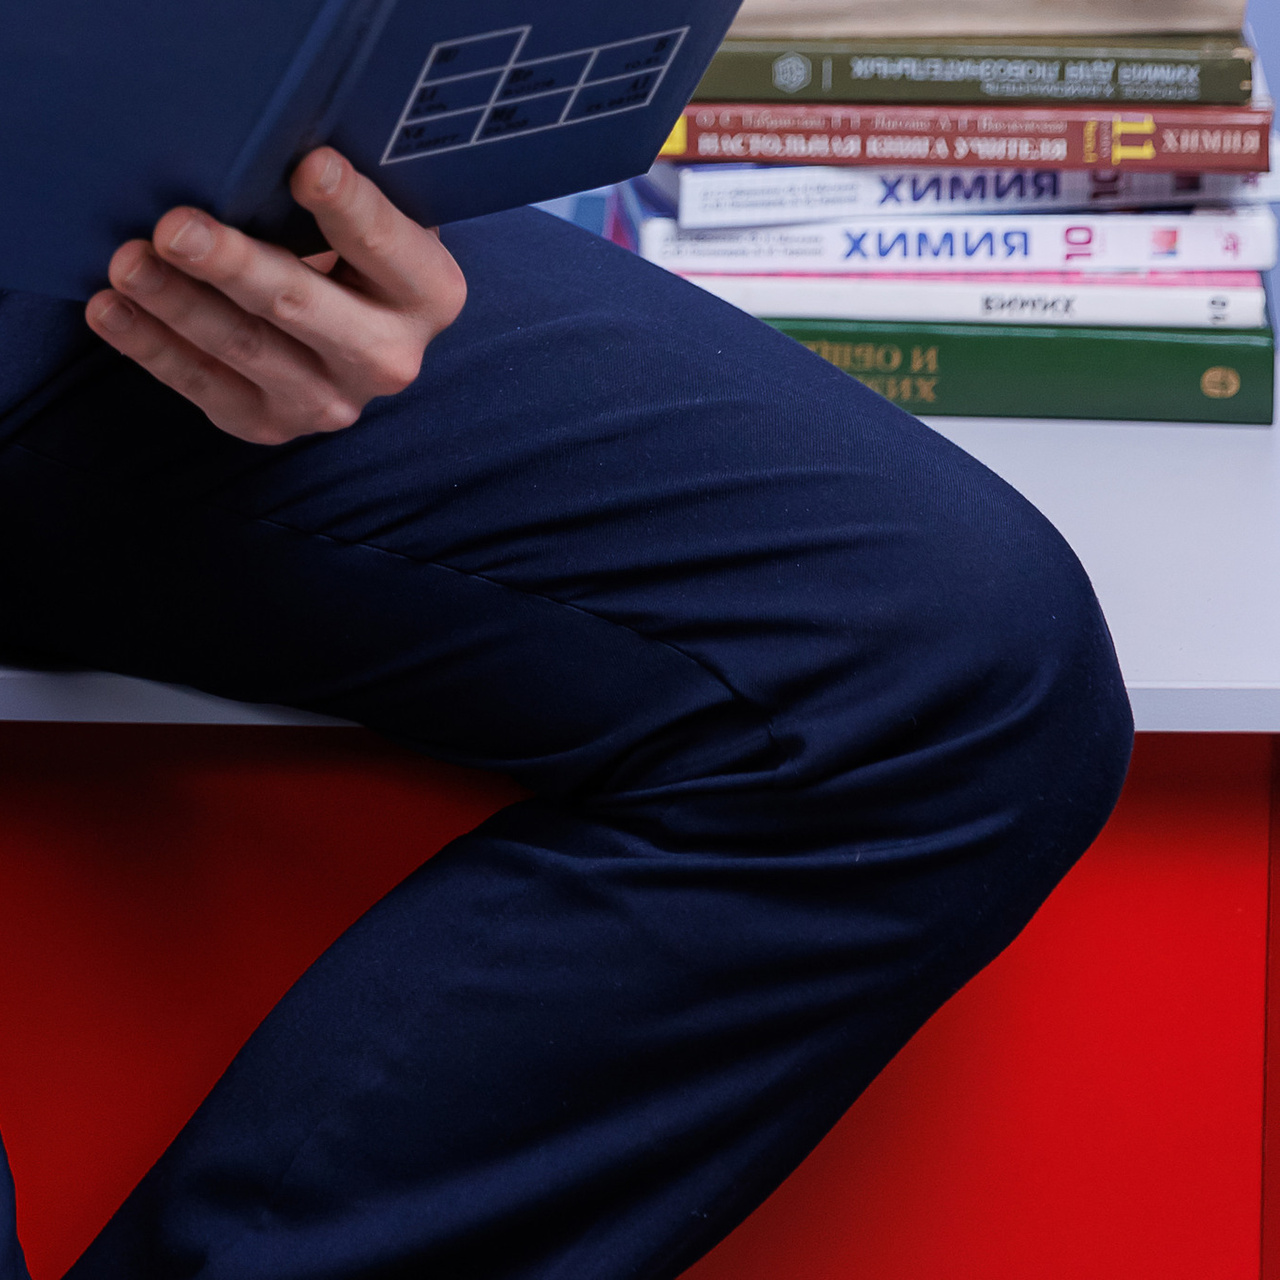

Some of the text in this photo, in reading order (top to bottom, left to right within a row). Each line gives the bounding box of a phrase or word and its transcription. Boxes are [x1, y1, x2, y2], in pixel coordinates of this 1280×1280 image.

[866, 135, 949, 159] КНИГА
[953, 137, 1068, 162] УЧИТЕЛЯ
[1111, 114, 1157, 165] 11
[1161, 128, 1261, 155] ХИМИЯ
[879, 170, 1060, 205] ХИМИЯ
[844, 230, 1029, 259] ХИМИЯ
[1064, 226, 1094, 261] 10
